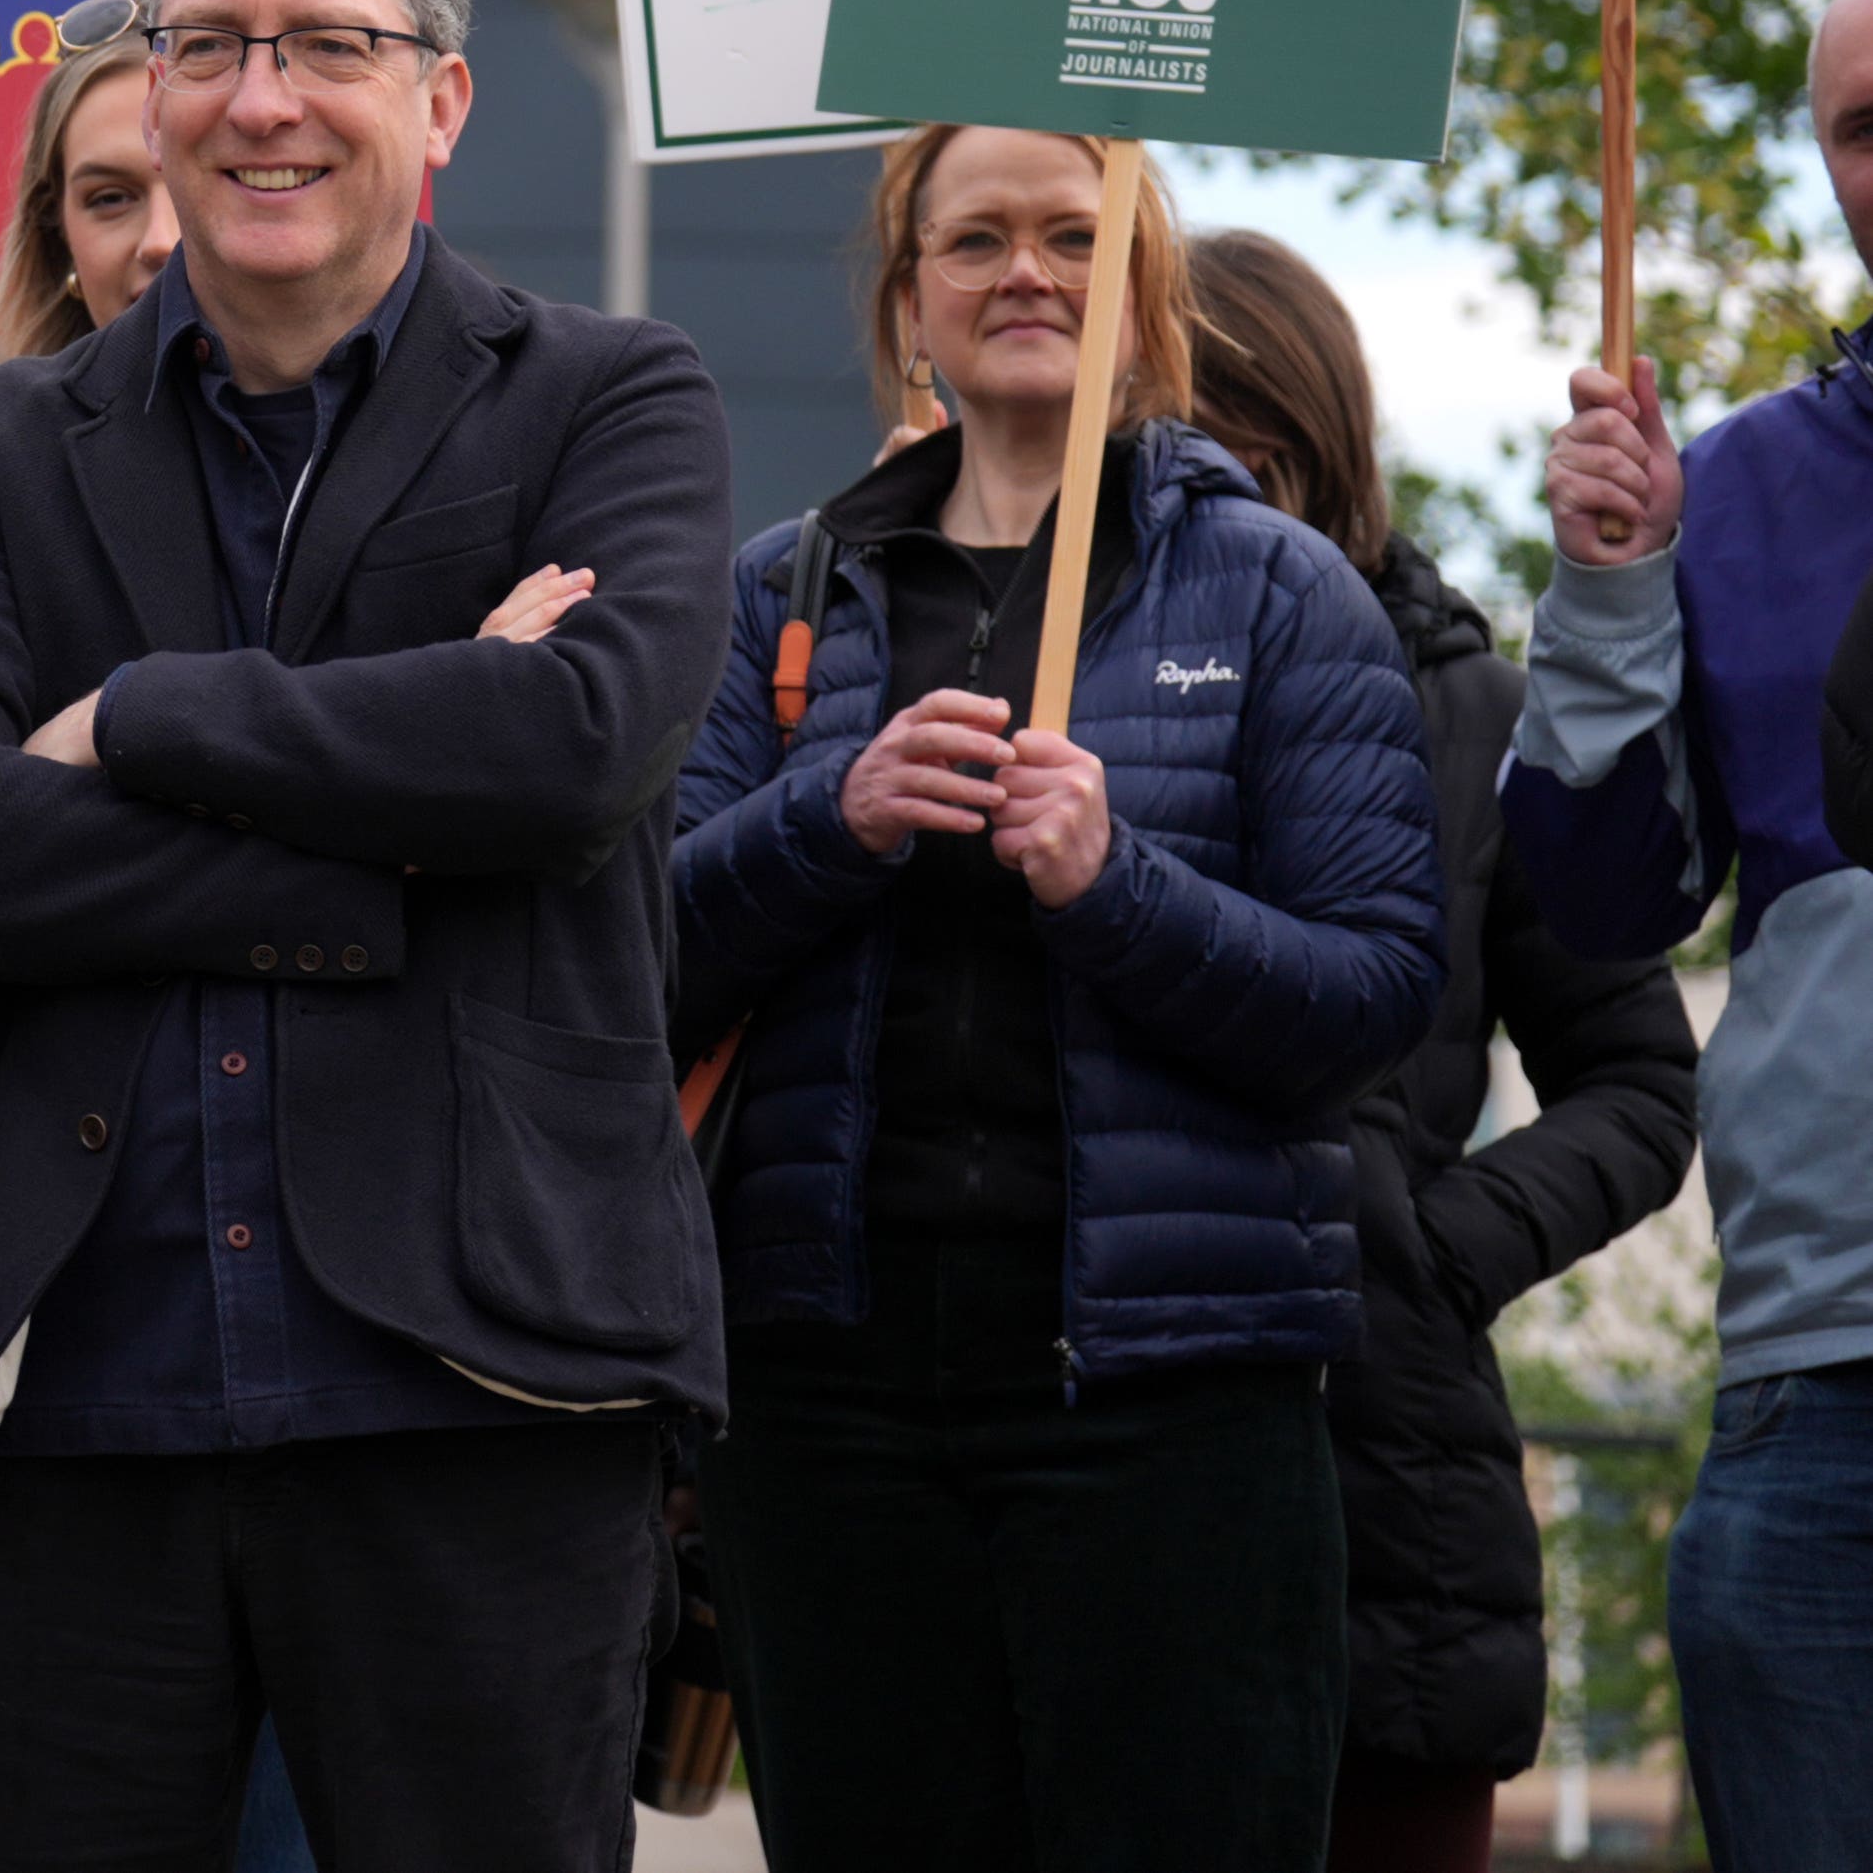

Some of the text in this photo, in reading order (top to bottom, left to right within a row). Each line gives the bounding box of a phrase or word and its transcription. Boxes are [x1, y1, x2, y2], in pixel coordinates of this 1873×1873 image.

[1067, 14, 1214, 40] NATIONAL UNION
[1128, 39, 1149, 54] OF
[1061, 53, 1208, 83] JOURNALISTS
